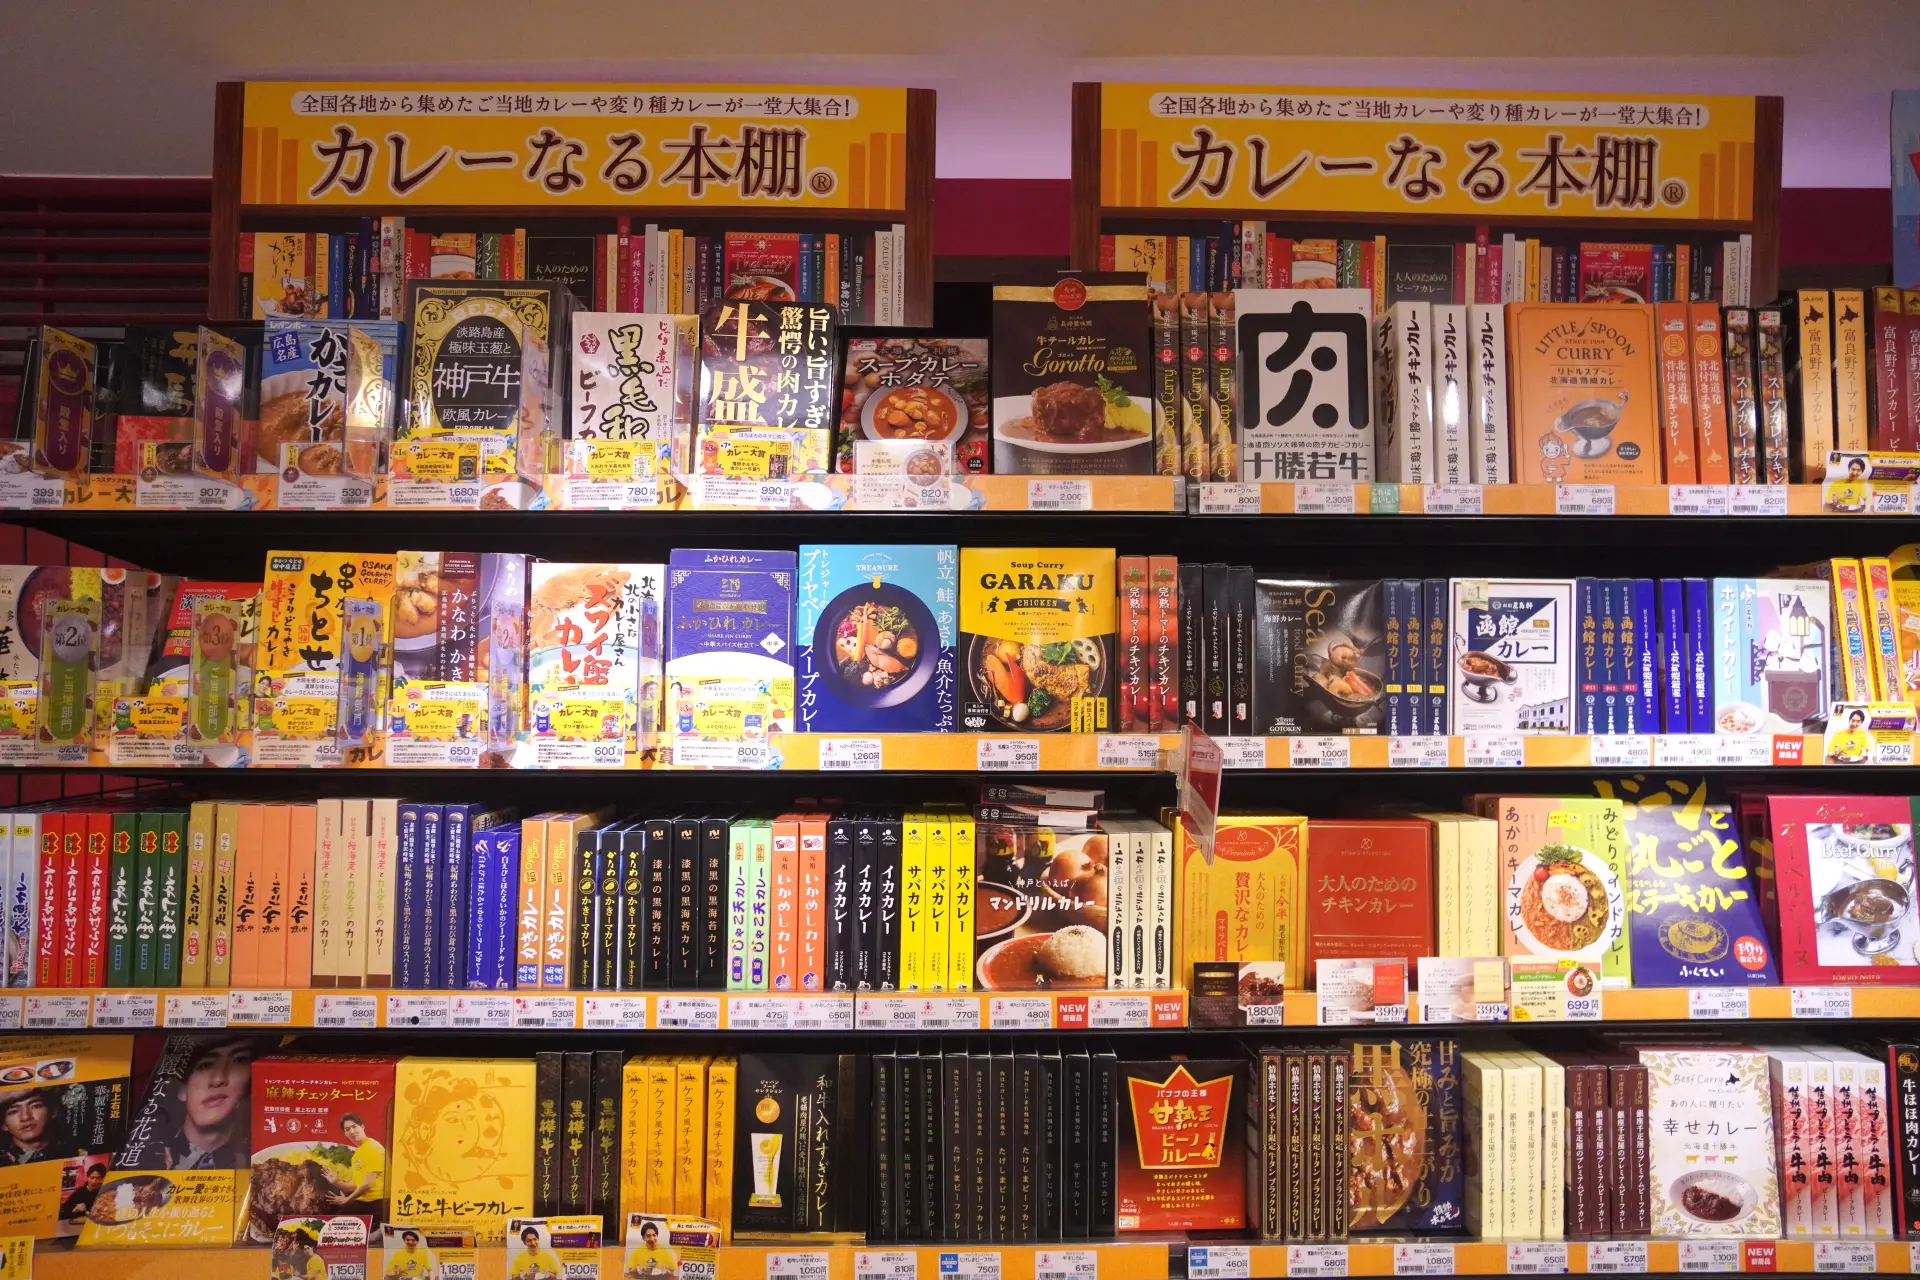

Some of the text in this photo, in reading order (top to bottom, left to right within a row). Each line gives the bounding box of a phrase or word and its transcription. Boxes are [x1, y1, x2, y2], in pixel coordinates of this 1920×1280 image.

[301, 94, 850, 118] 全国各地から集めたご当地カレーや変り種カレーが一堂大集合!
[1159, 95, 1701, 126] 全国各地から集めたご当地カレーや変り種カレーが一堂大集合!
[533, 264, 588, 275] 大人のための
[881, 235, 890, 323] SCALLOP SOUP CURRY
[273, 336, 296, 351] 広島
[448, 341, 511, 355] 極味玉葱と
[456, 326, 505, 339] 淡路島産
[1036, 335, 1106, 346] 牛テールカレー
[1407, 310, 1421, 385] チキンカレー
[1535, 322, 1635, 357] LITTLE SPOON
[276, 347, 299, 362] 名産
[707, 303, 771, 423] 牛盛
[859, 356, 978, 373] スープカレー
[1023, 347, 1105, 376] Gorotto
[1556, 347, 1614, 361] CURRY
[433, 363, 520, 399] 神戸牛
[880, 372, 950, 387] ホタテ
[1162, 369, 1178, 404] Curry
[1677, 359, 1690, 404] 北海道発
[1808, 328, 1823, 435] 富良野スープカレー
[442, 408, 507, 423] 欧風カレー
[1666, 360, 1678, 447] 骨付きチキンカレー
[1243, 451, 1369, 480] 十勝若牛
[361, 560, 392, 571] OSAKA
[704, 555, 763, 564] ふかひれカレー
[855, 563, 899, 572] TREASURE
[1010, 560, 1065, 571] Soup Curry
[979, 572, 1094, 591] GARAKU
[451, 589, 468, 643] かなわ
[1016, 599, 1058, 607] CHICKEN
[1263, 614, 1302, 623] 海鮮カレー
[1304, 588, 1336, 646] Sea
[297, 571, 334, 672] ちとせ
[677, 614, 781, 632] ふかひれカレー
[1474, 613, 1517, 637] 函館
[801, 549, 820, 732] ブイヤベーススープカレー
[1129, 586, 1141, 706] 完熟トマトのチキンカレー
[1157, 586, 1171, 707] 完熟トマトのチキンカレー
[1386, 615, 1400, 681] 函館カレー
[1407, 615, 1420, 681] 函館カレー
[1497, 640, 1550, 659] カレー
[1719, 585, 1737, 697] ホワイトカレー
[1775, 740, 1802, 751] NEW
[1631, 829, 1747, 880] 丸ごと
[1821, 841, 1902, 861] Beef Curry
[1016, 879, 1070, 888] 神戸といえば
[1317, 876, 1417, 893] 大人のための
[1505, 806, 1524, 945] あかのキーマカレー
[1603, 807, 1623, 965] みどりのインドカレー
[651, 858, 664, 970] 漆黒の黒海苔カレー
[680, 858, 691, 969] 漆黒の黒海苔カレー
[732, 866, 746, 951] じゃこ天カレー
[833, 864, 847, 934] イカカレー
[858, 864, 873, 934] イカカレー
[907, 865, 922, 932] サバカレー
[932, 865, 946, 932] サバカレー
[989, 896, 1096, 911] マンドリルカレー
[1255, 871, 1266, 930] 大人のための
[1321, 897, 1415, 913] チキンカレー
[520, 887, 539, 960] かきカレー
[777, 874, 792, 969] いかめしカレー
[1059, 1003, 1086, 1015] NEW
[1154, 1002, 1182, 1013] NEW
[109, 1083, 122, 1119] 尾上右近
[1156, 1089, 1208, 1098] バナナの王様
[1669, 1099, 1745, 1109] あの人に贈りたい
[1149, 1099, 1213, 1131] 甘熟王
[1437, 1040, 1461, 1183] 甘みと旨みが
[1662, 1117, 1758, 1136] 幸せカレー
[1902, 1078, 1920, 1176] 牛ほほ肉カレー
[627, 1087, 638, 1185] ケララ風チキンカレー
[653, 1088, 663, 1185] ケララ風チキンカレー
[815, 1073, 831, 1227] 和牛入れすぎカレー
[1683, 1141, 1737, 1151] 北海道十勝牛
[1788, 1085, 1807, 1184] 信州プレミアム牛肉
[1161, 1149, 1201, 1163] カレー
[1575, 1110, 1584, 1230] 銀座千疋屋のプレミアムビーフカレー
[1595, 1110, 1605, 1230] 銀座千疋屋のプレミアムビーフカレー
[396, 1194, 525, 1217] 近江牛ビーフカレー
[879, 1152, 888, 1238] 佐賀牛ビーフカレー
[975, 1147, 984, 1239] たけしまビーフカレー
[1747, 1247, 1774, 1257] NEW
